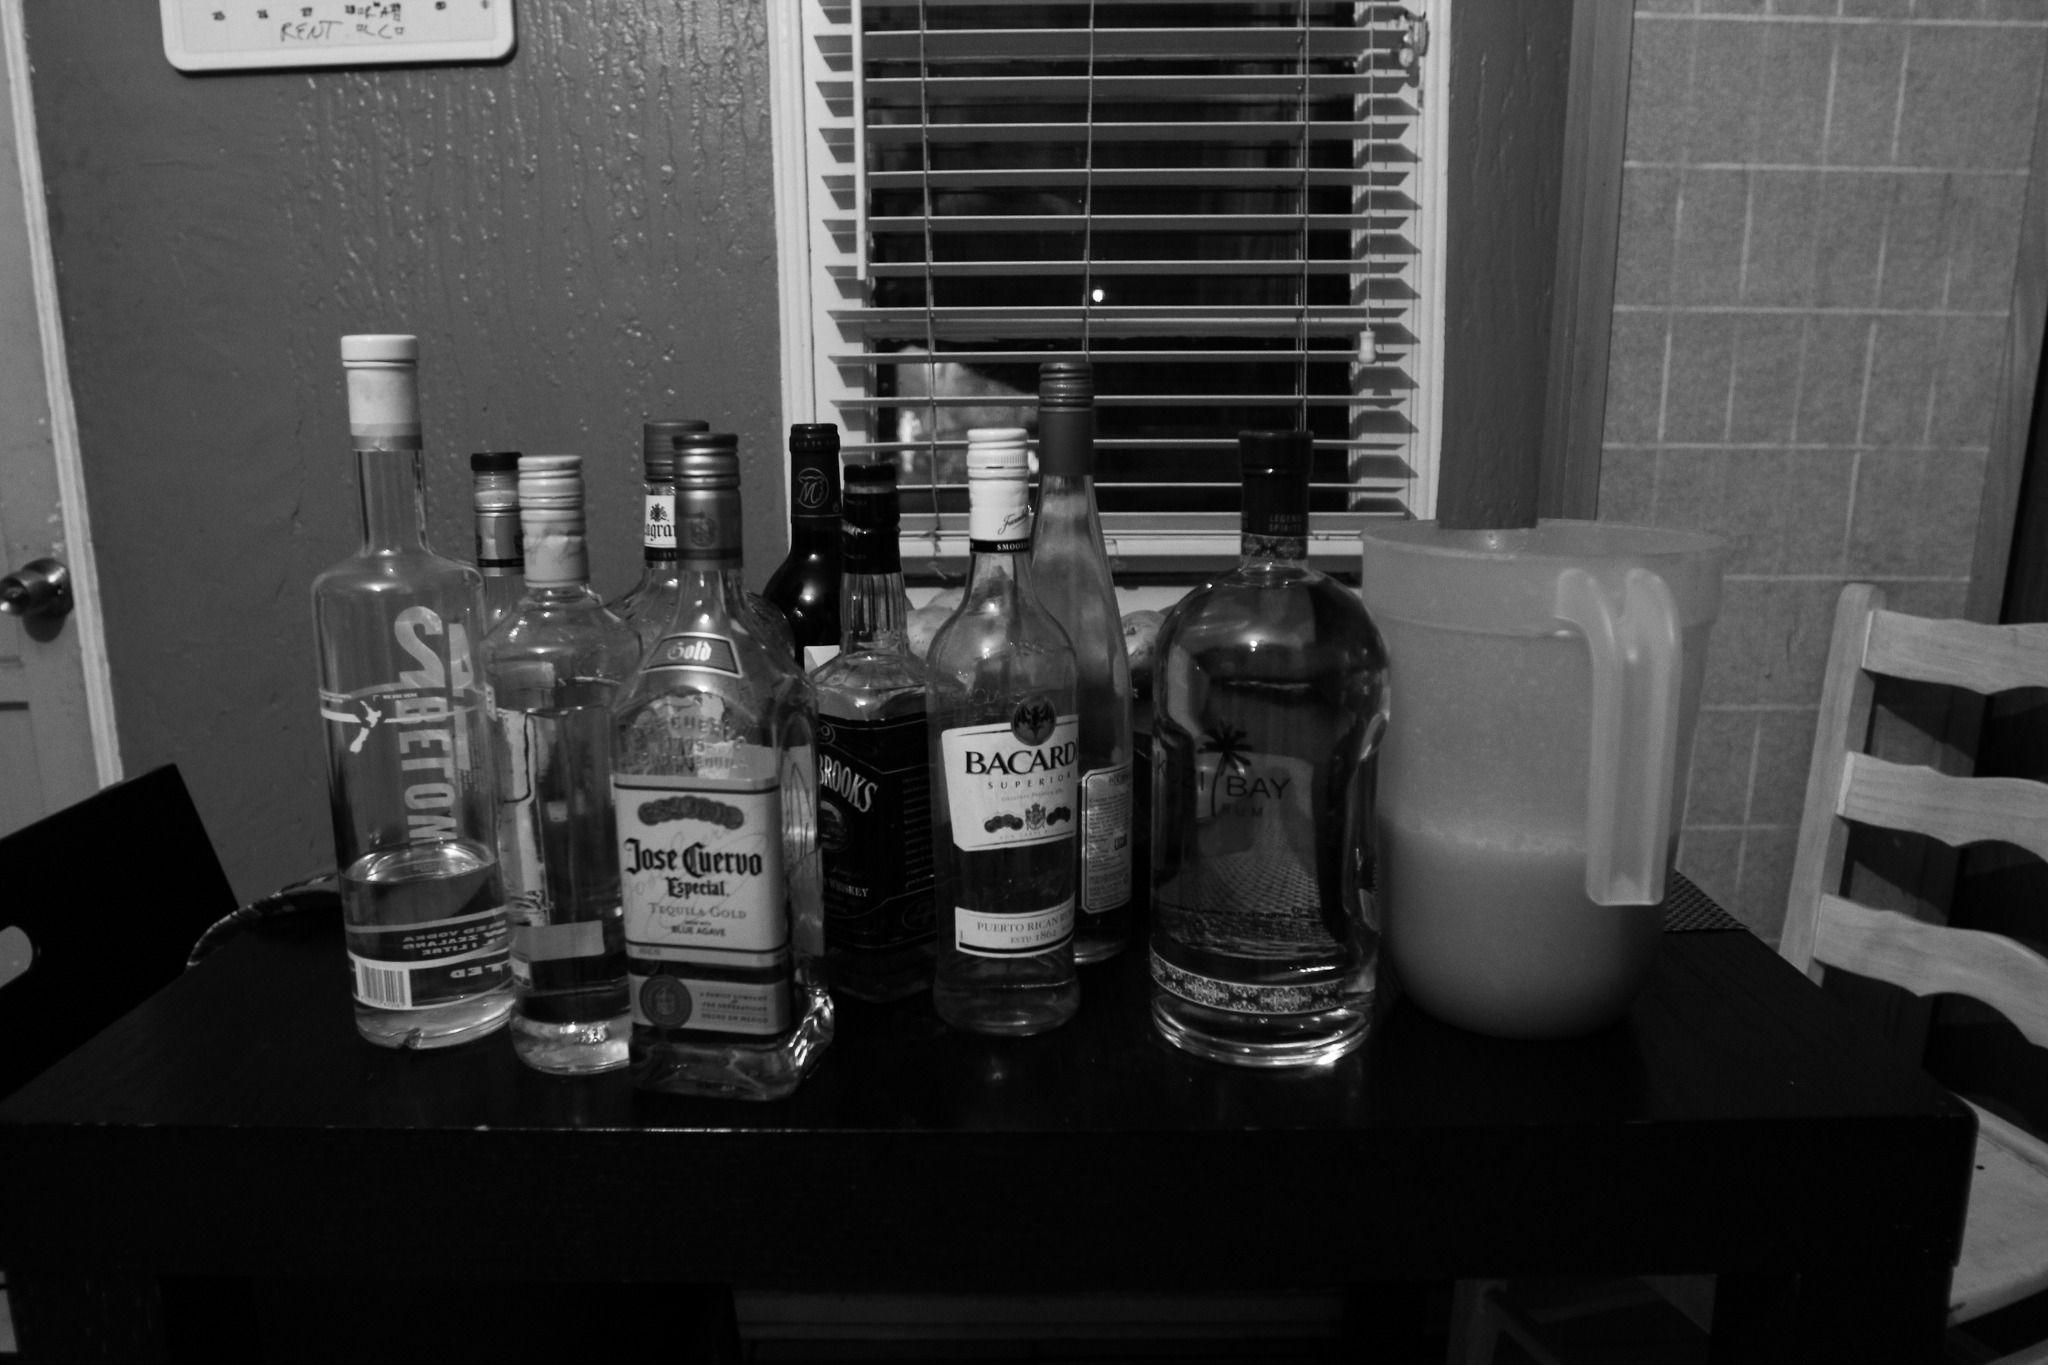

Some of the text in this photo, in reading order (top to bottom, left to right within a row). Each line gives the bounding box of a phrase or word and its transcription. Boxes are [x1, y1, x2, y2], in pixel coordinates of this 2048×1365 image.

[280, 20, 343, 42] RENT
[667, 640, 712, 661] Gold
[1227, 775, 1291, 800] BAY
[624, 838, 763, 878] Jose Cuervo
[665, 876, 726, 900] Especial
[977, 920, 1024, 933] PUERTO
